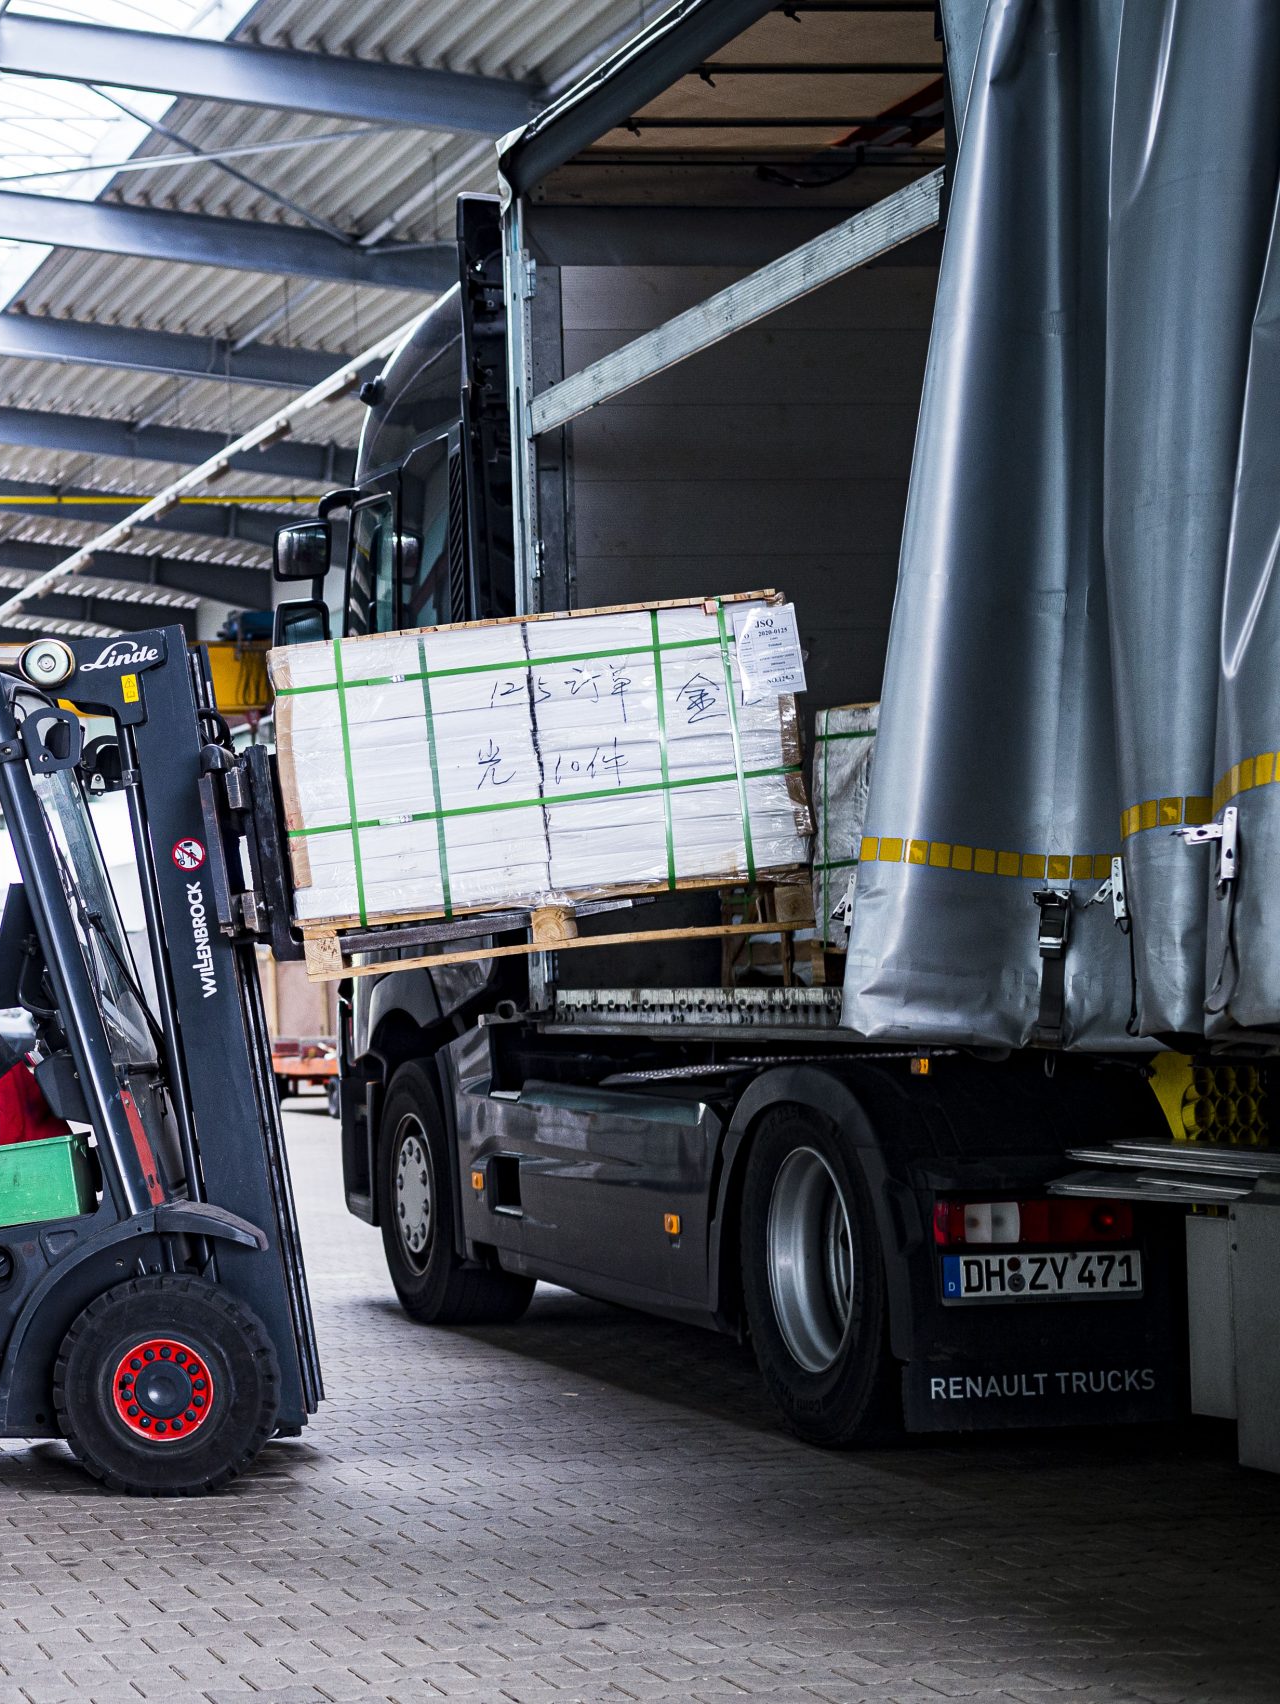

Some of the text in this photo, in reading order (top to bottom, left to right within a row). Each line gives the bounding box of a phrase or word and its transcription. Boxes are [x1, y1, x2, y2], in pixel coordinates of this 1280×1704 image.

[754, 618, 774, 629] JSQ
[80, 641, 159, 672] Linde
[185, 881, 218, 998] WILLENBROCK
[948, 1281, 956, 1292] D
[963, 1255, 1138, 1293] DH ZY 471
[930, 1368, 1156, 1400] RENAULT TRUCKS
